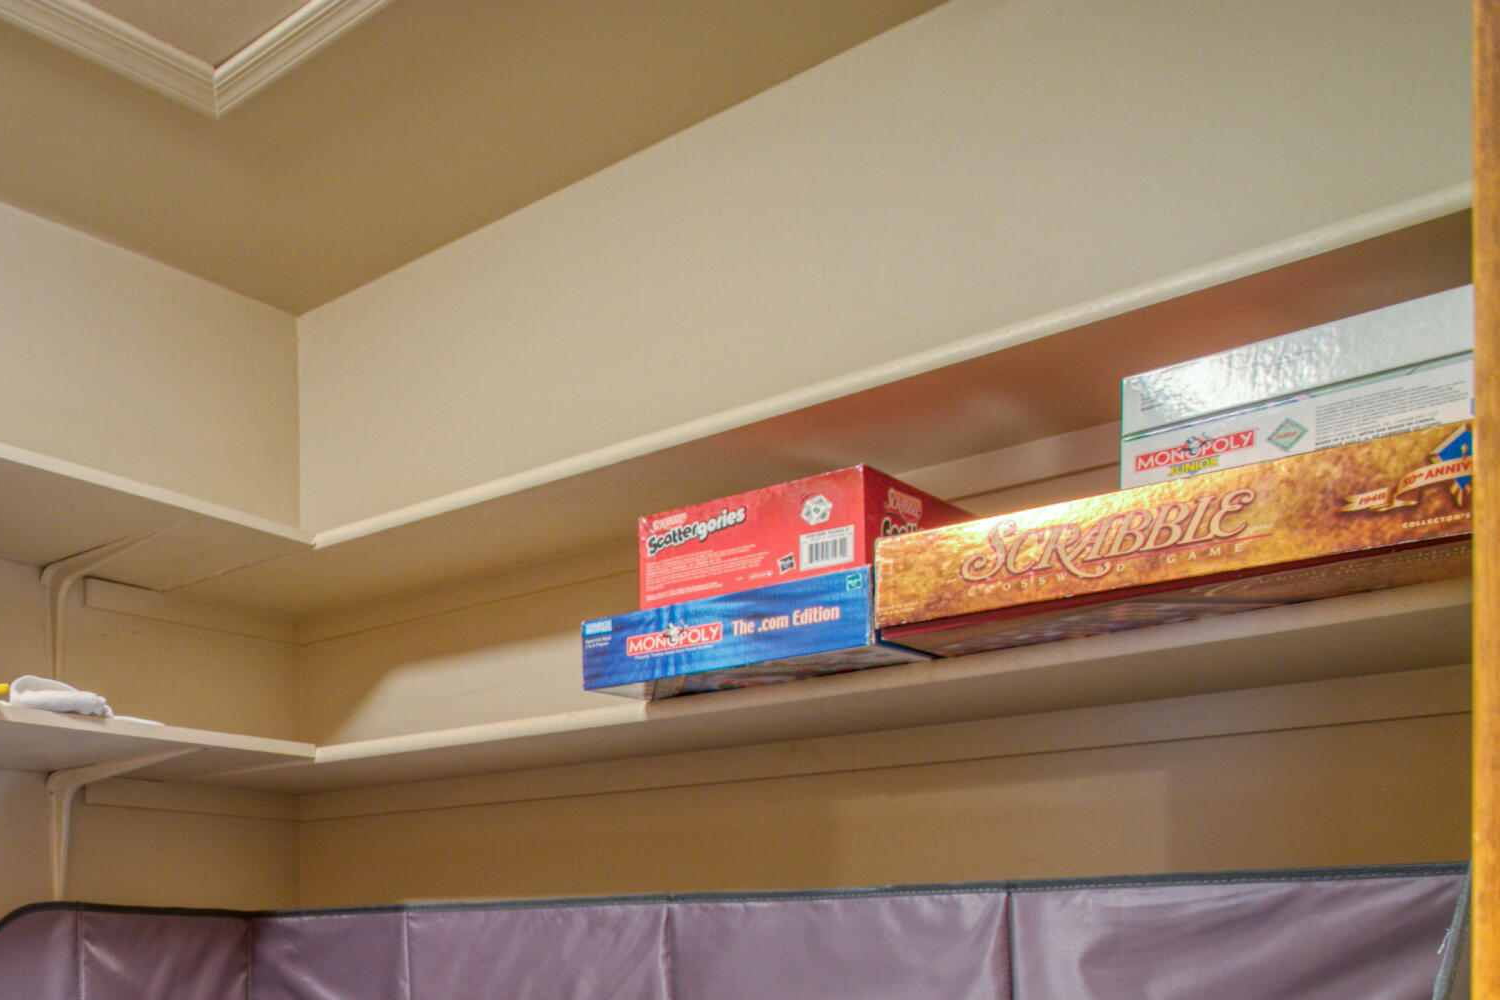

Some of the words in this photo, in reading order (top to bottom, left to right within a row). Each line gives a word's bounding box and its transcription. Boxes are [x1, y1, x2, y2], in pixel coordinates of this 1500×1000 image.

[1137, 431, 1254, 471] MONOPOLY
[1169, 456, 1219, 477] JUNIOR
[1358, 492, 1386, 505] 1948
[646, 506, 746, 557] Scattergories
[1402, 513, 1471, 528] COLLECTOR'S
[962, 489, 1254, 582] SCRABBLE
[1166, 541, 1246, 564] GAME
[732, 618, 755, 637] The
[757, 613, 789, 633] .com
[793, 606, 840, 627] Edition
[629, 625, 720, 653] MONOPOLY
